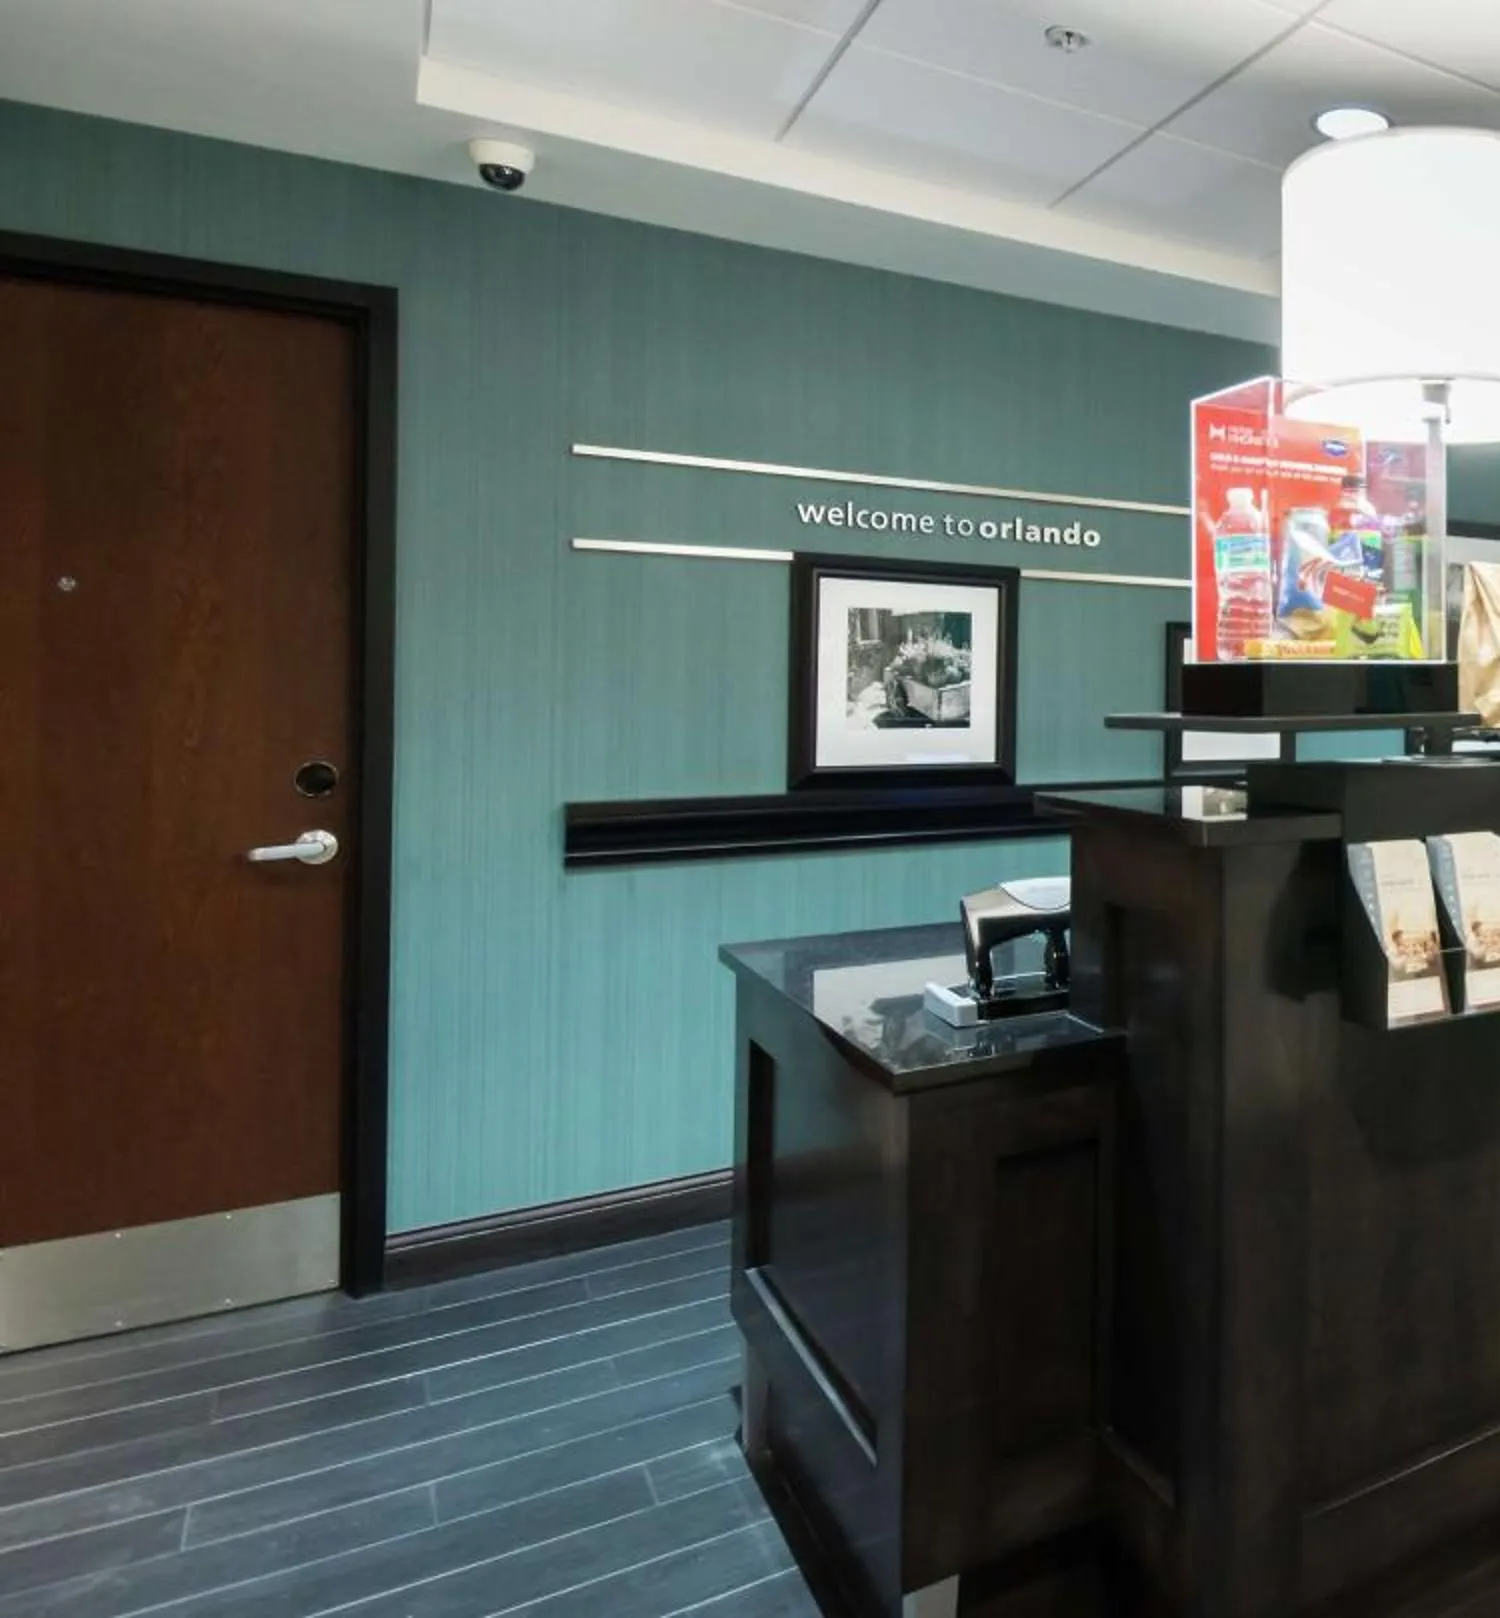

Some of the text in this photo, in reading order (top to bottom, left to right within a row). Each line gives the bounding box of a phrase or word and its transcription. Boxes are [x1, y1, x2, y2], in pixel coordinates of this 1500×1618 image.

[797, 501, 1101, 548] welcome to orlando
